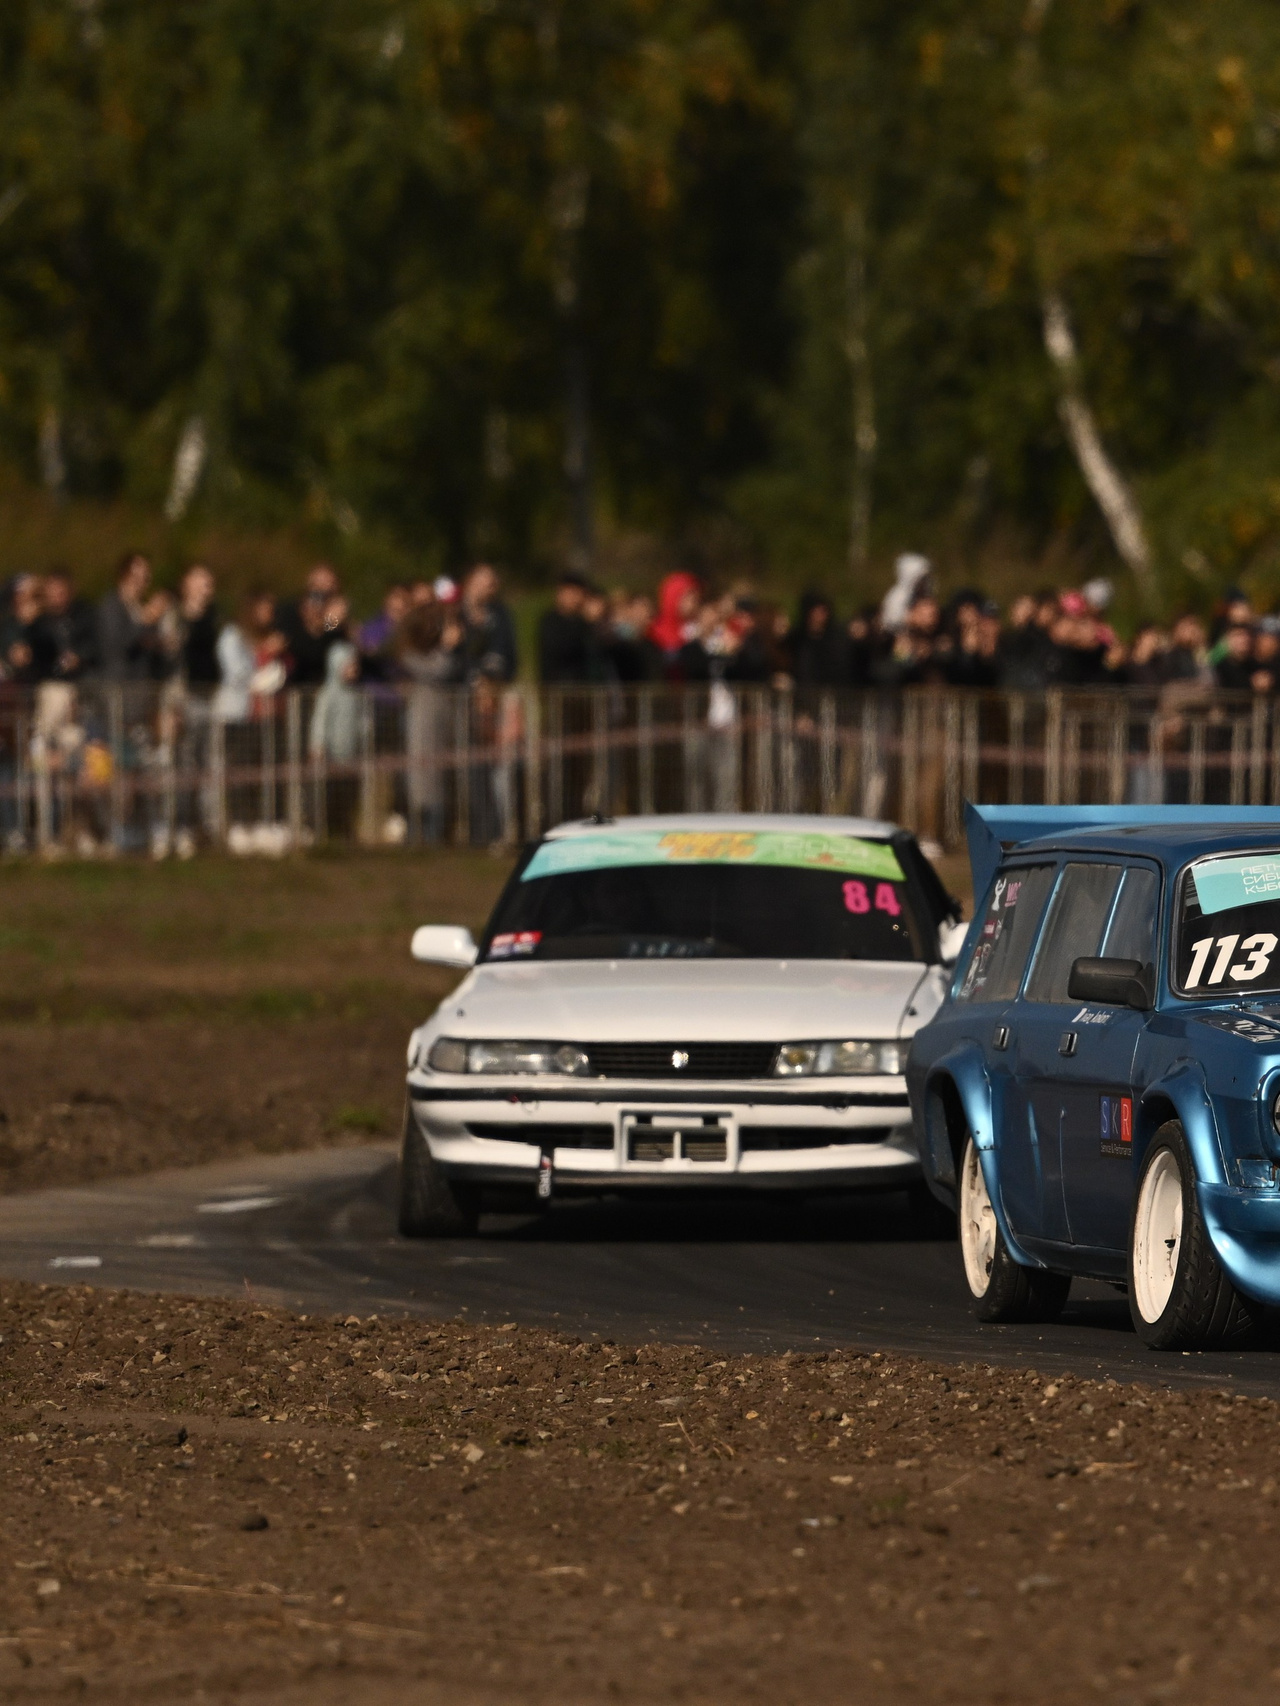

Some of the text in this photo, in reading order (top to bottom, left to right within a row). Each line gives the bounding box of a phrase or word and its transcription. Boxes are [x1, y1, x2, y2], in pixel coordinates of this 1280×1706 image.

[842, 880, 901, 916] 84
[1184, 933, 1279, 990] 113
[1102, 1101, 1130, 1136] SKR
